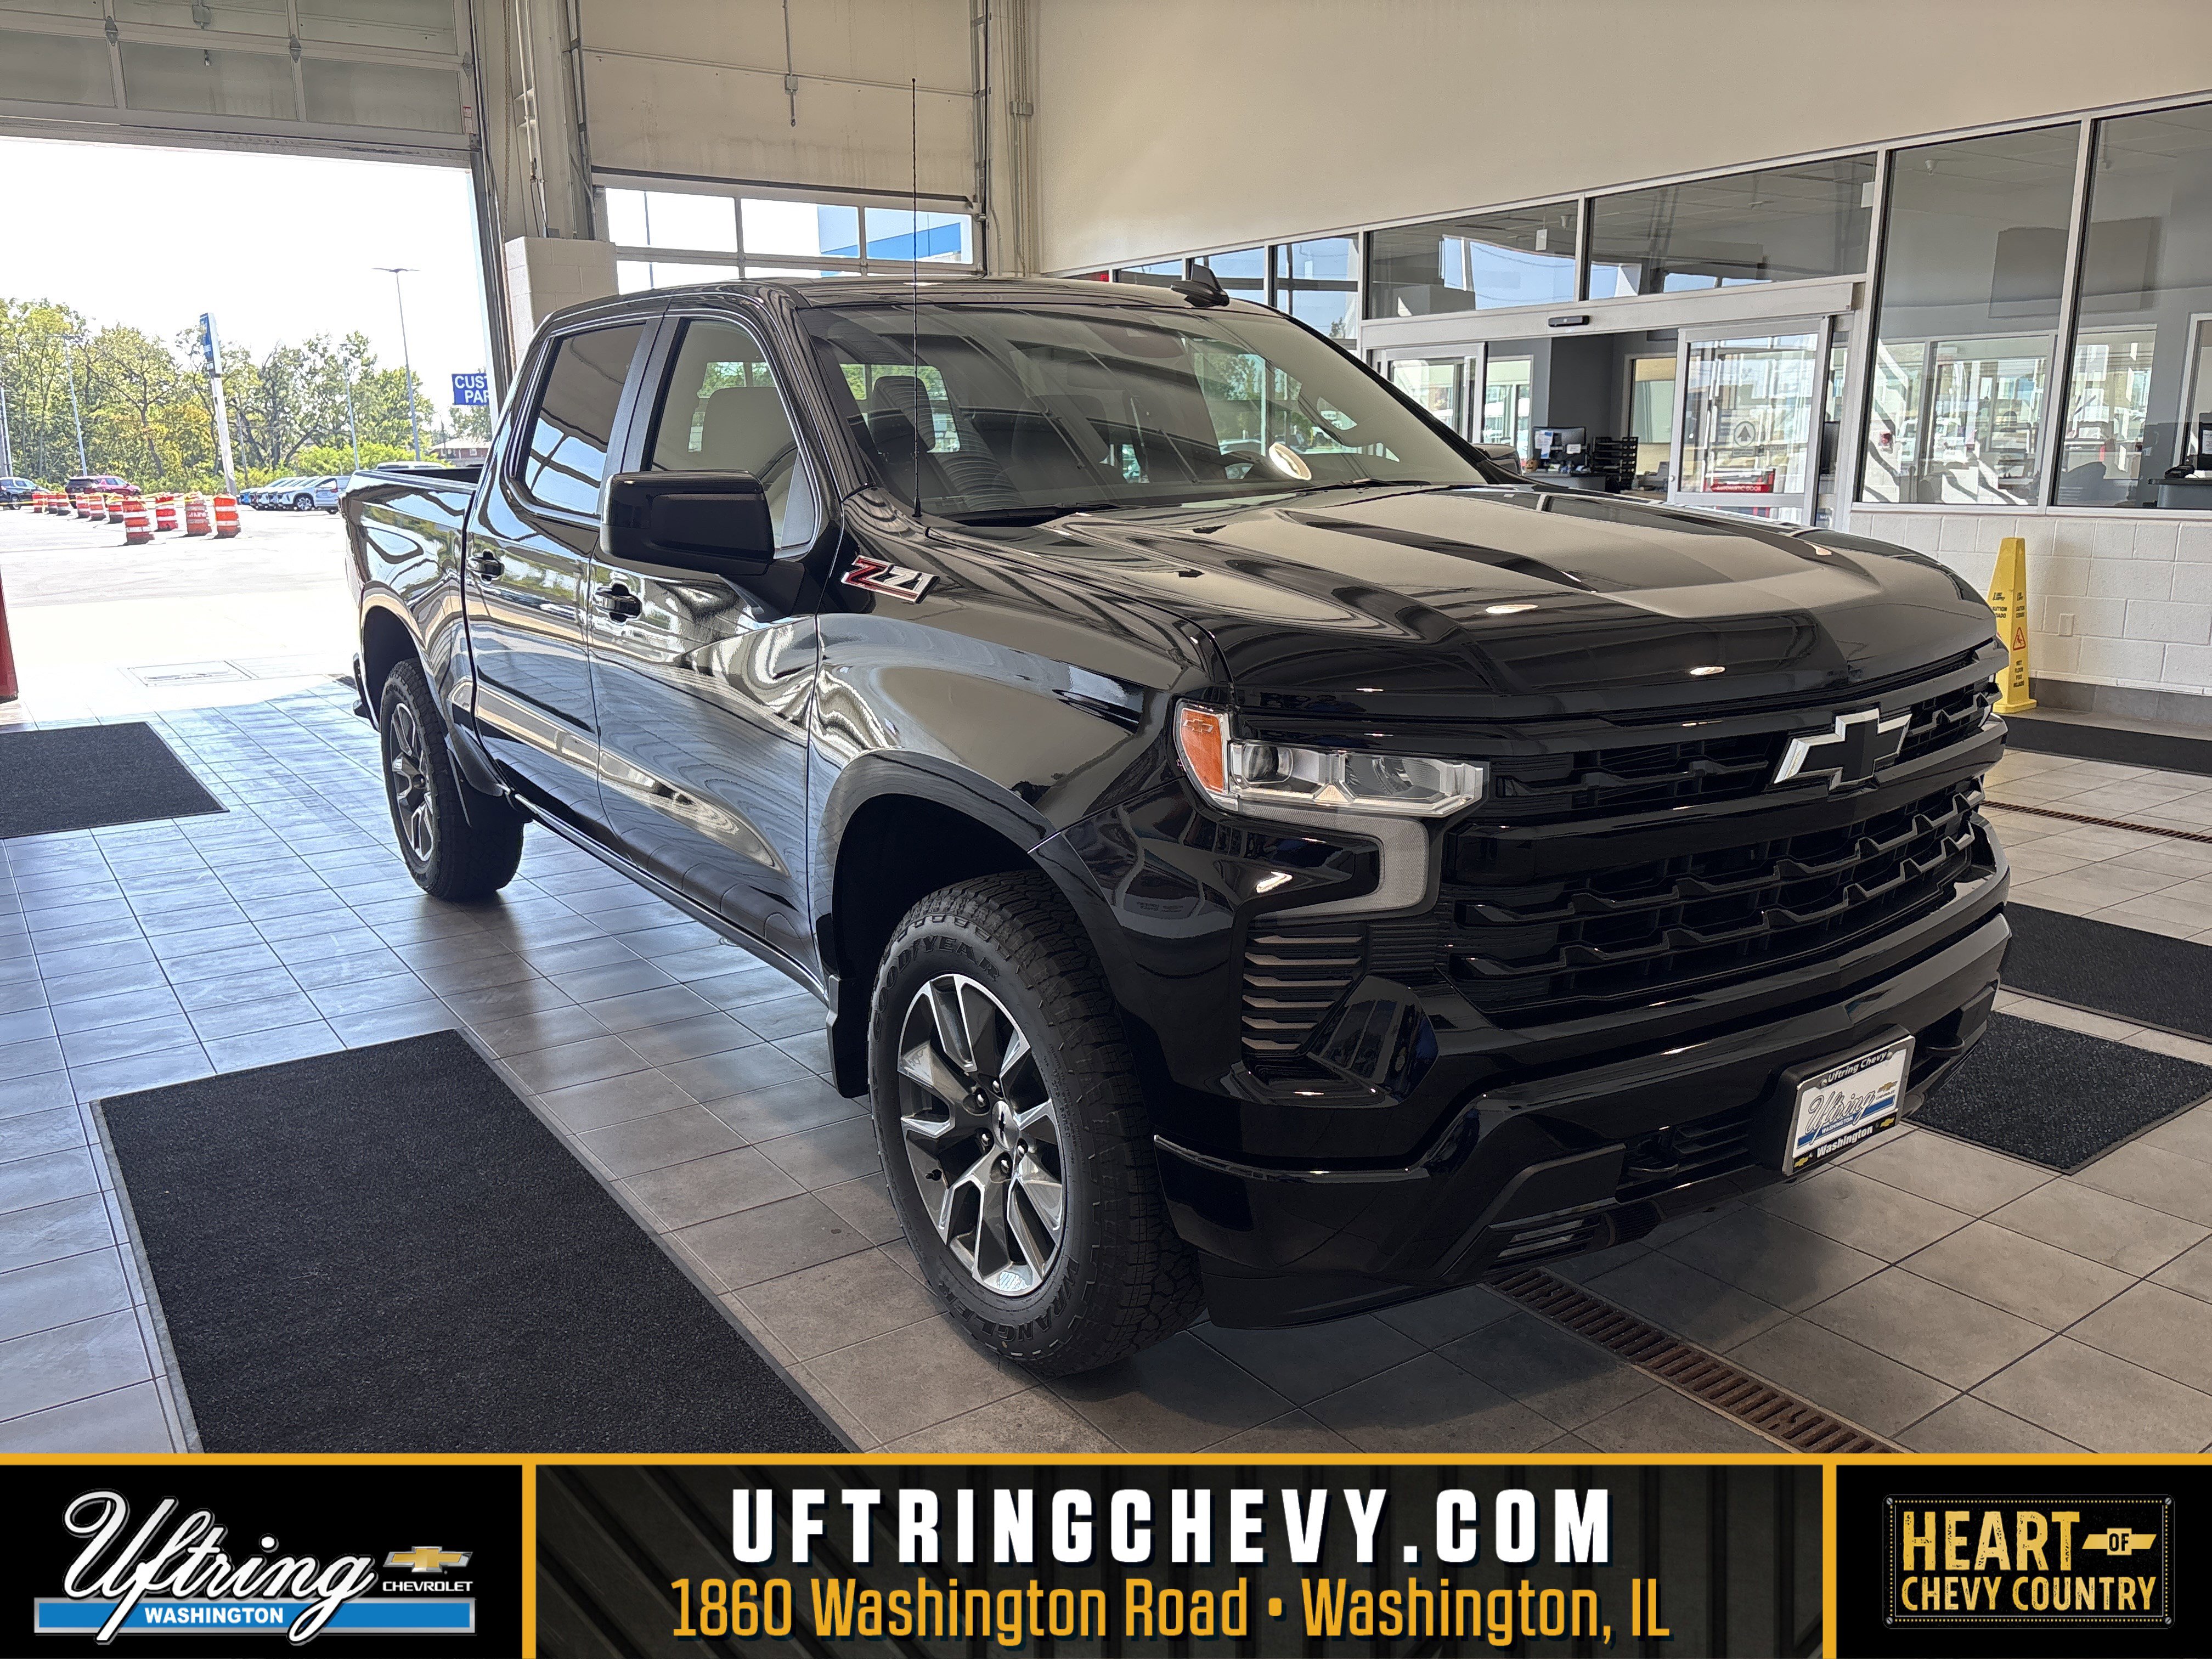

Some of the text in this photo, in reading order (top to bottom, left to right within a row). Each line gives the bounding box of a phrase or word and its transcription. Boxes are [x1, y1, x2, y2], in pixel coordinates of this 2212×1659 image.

[455, 375, 487, 389] CUS
[841, 555, 940, 603] Z71
[1827, 1052, 1887, 1083] Uftring Chevy
[1804, 1091, 1876, 1146] Uftring
[1821, 1116, 1853, 1135] WASHINGTON
[1816, 1125, 1873, 1158] Washington
[939, 1255, 1080, 1342] WRANGLER
